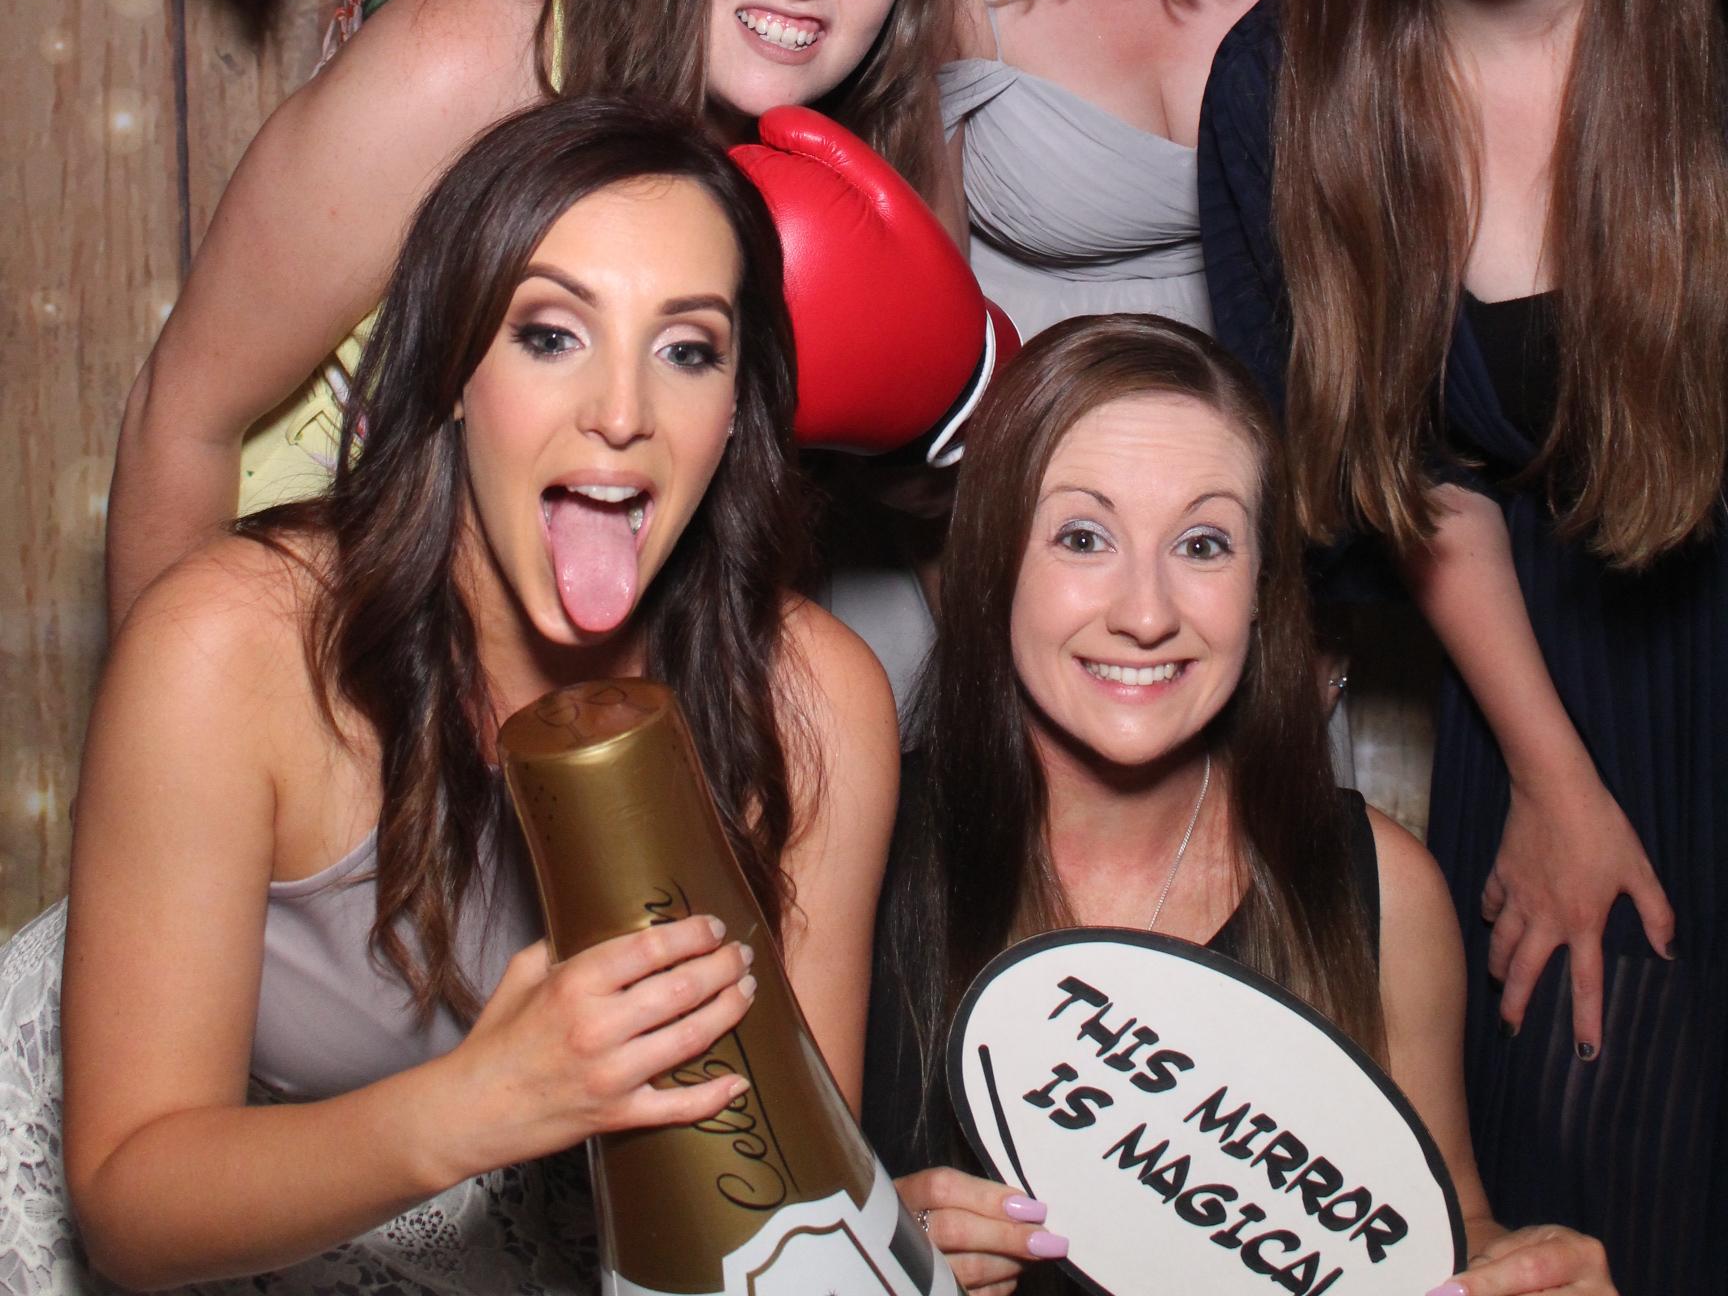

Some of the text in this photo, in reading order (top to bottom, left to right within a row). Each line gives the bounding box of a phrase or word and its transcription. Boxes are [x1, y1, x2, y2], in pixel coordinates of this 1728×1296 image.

[1022, 1062, 1114, 1130] IS
[1048, 975, 1409, 1264] THIS MIRROR
